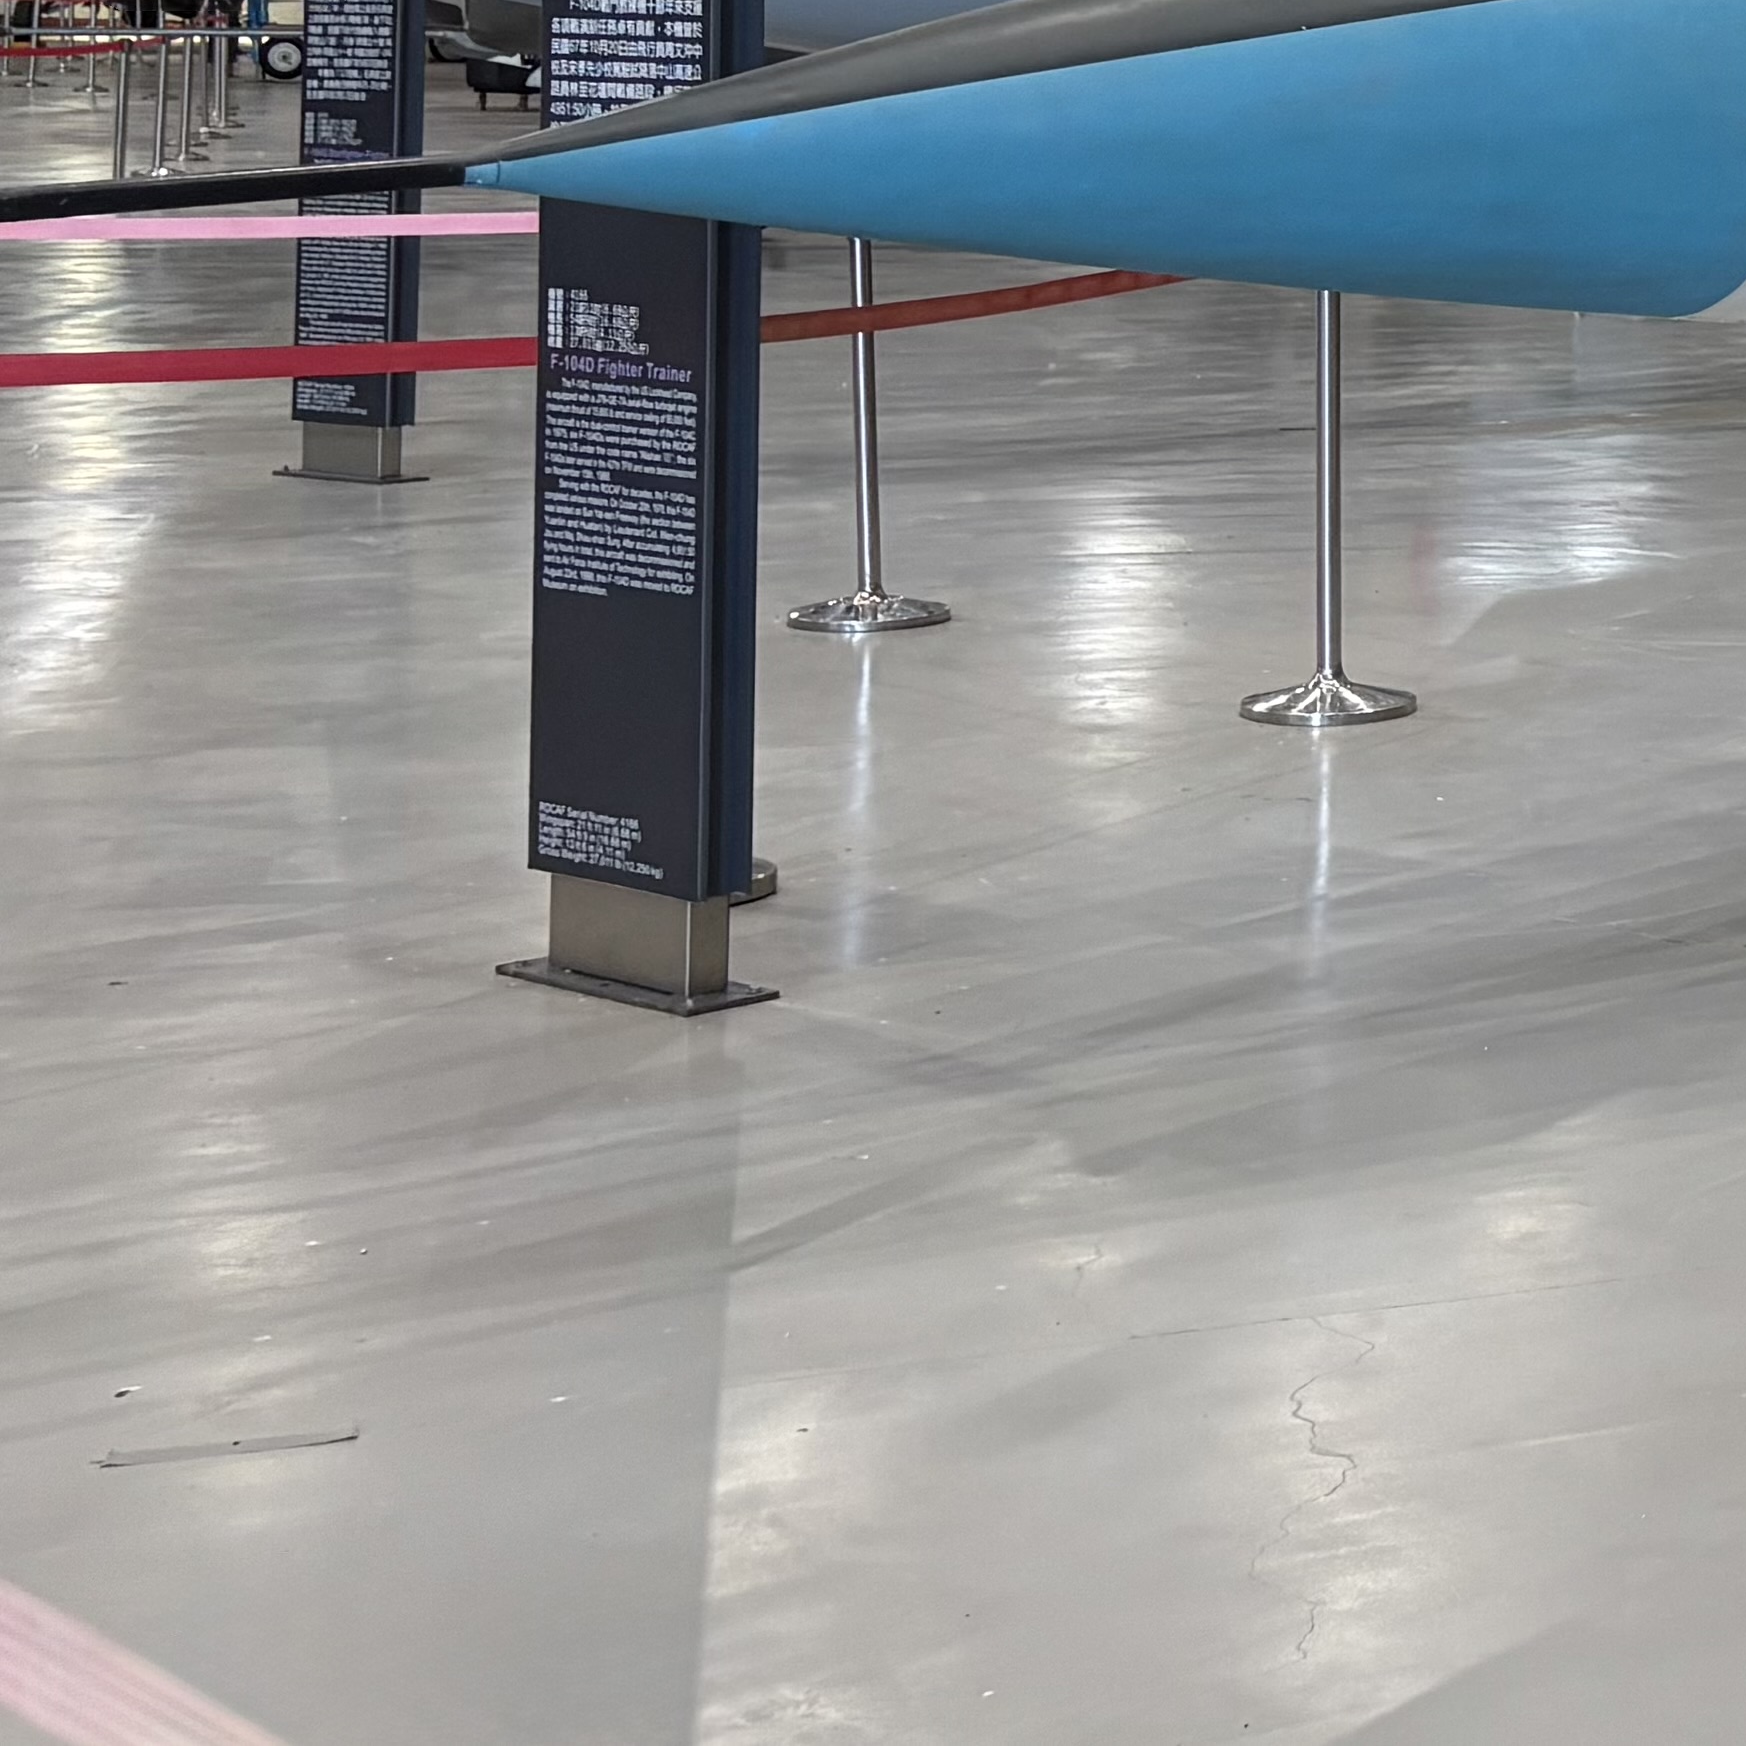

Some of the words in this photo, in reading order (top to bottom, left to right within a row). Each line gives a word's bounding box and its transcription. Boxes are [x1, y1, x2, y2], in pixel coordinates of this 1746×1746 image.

[550, 353, 594, 373] F-104D
[597, 358, 643, 380] Fighter
[646, 362, 692, 383] Trainer
